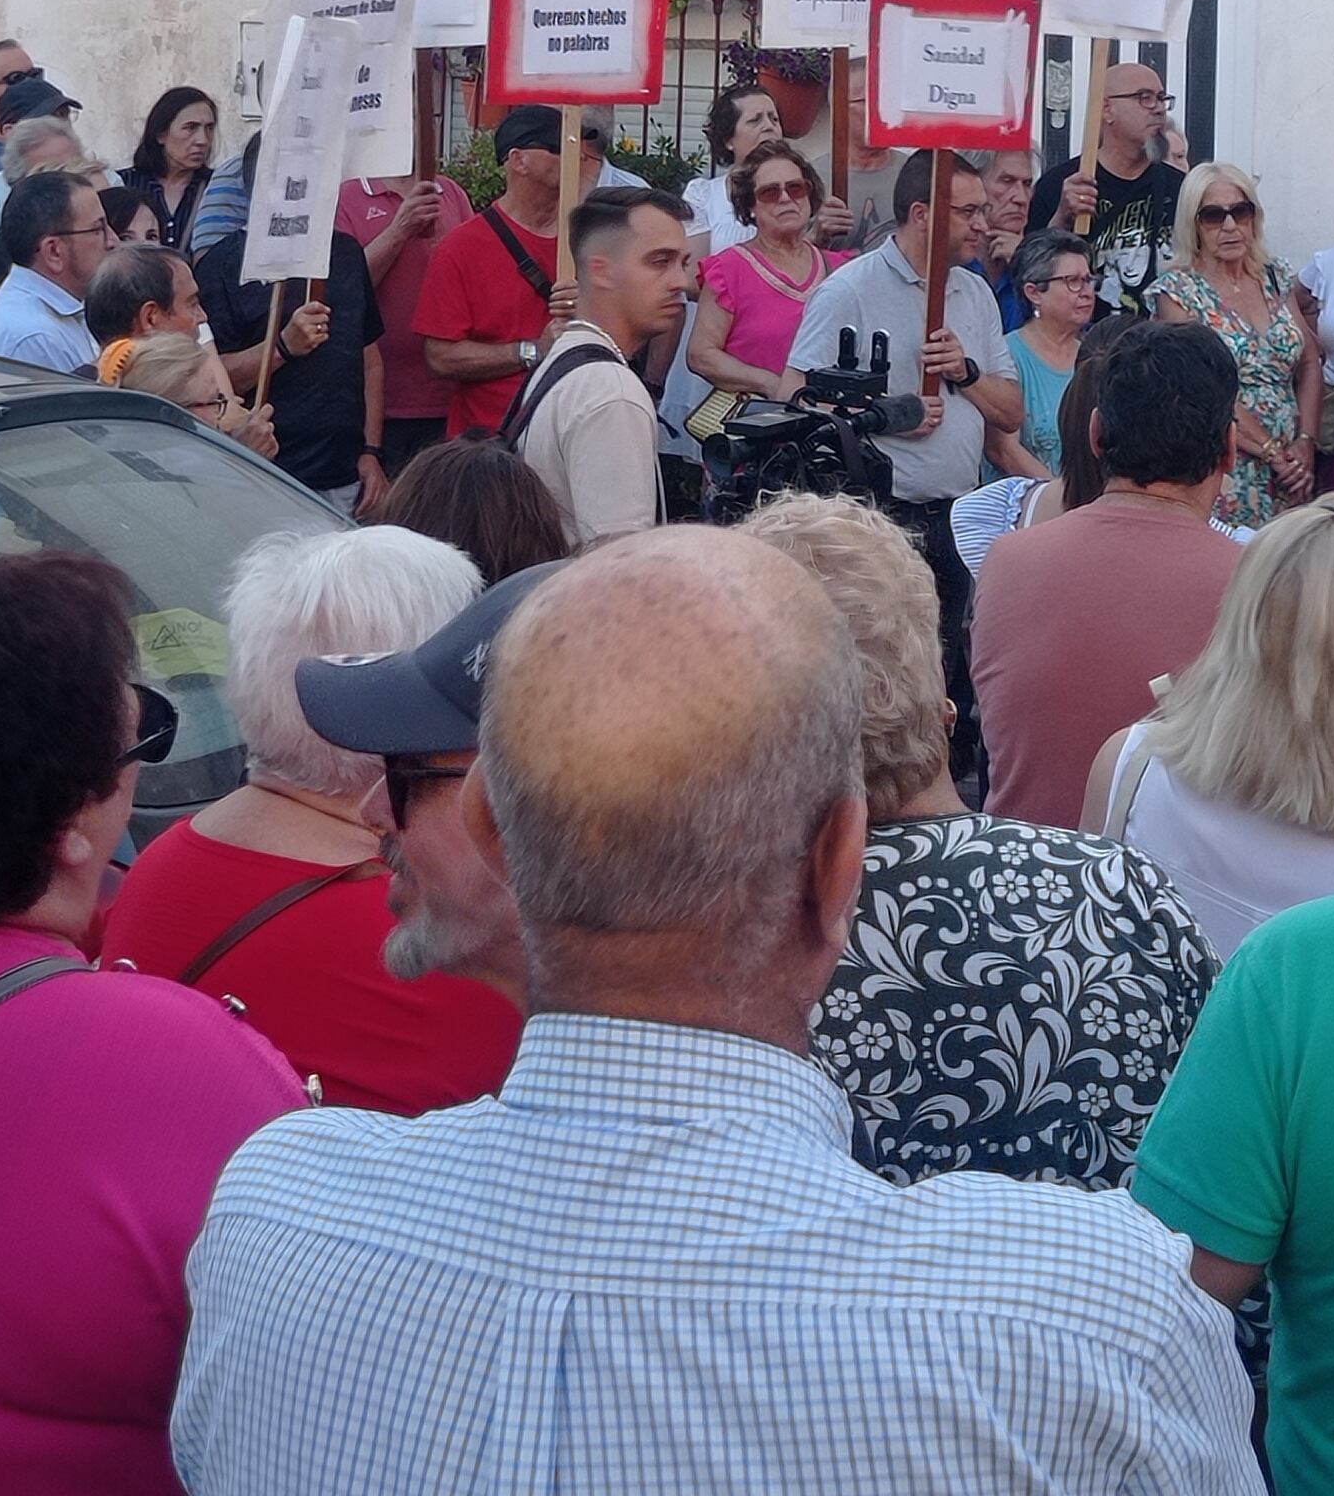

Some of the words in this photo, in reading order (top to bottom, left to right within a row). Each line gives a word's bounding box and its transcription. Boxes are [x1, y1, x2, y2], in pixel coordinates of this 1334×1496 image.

[532, 8, 586, 28] Queremos
[587, 8, 627, 25] hechos
[548, 37, 562, 52] no
[563, 33, 610, 53] palabras
[923, 44, 986, 65] Sanidad
[358, 64, 371, 84] de
[928, 84, 977, 110] Digna
